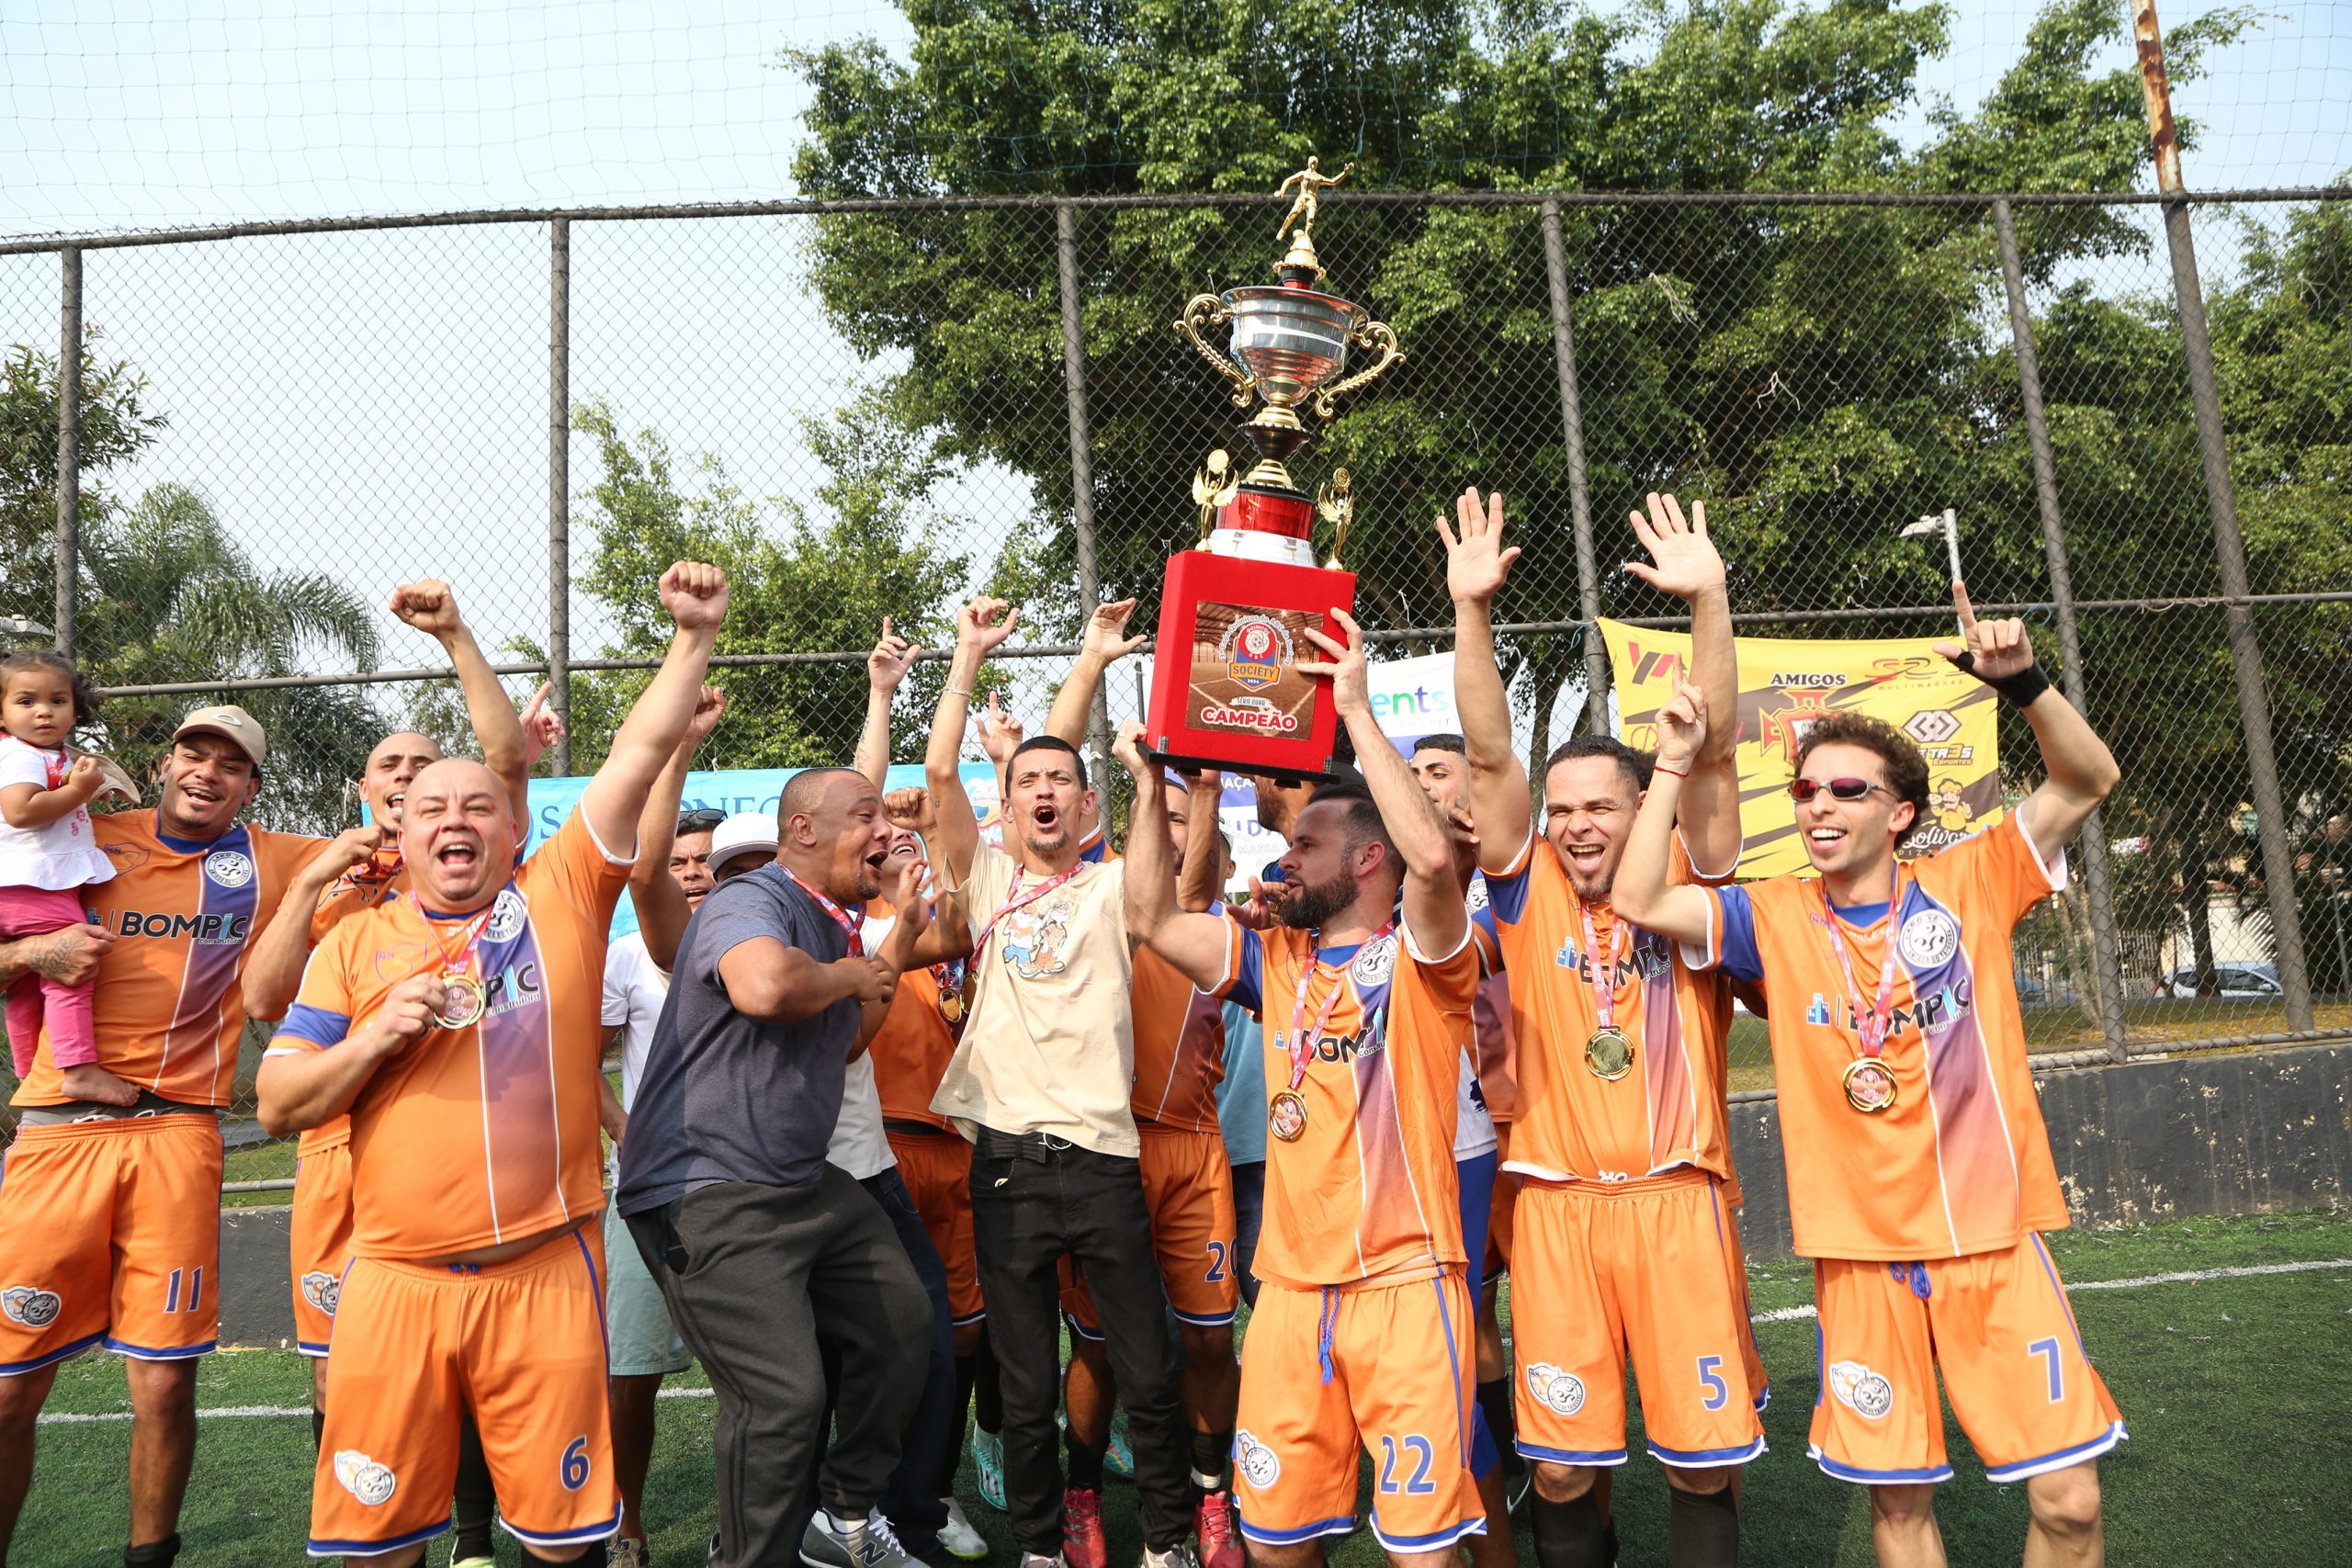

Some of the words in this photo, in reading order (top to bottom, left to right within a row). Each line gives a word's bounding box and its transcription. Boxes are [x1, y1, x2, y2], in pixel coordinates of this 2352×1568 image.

[1233, 665, 1276, 678] SOCIETY
[1770, 672, 1846, 685] AMIGOS
[1878, 680, 1963, 690] MULTIMARCAS
[1202, 708, 1297, 730] CAMPEÃO
[120, 911, 247, 938] BOMPIC
[482, 963, 539, 1010] PIC
[163, 1266, 203, 1314] 11
[1696, 1354, 1729, 1411] 5
[2028, 1334, 2064, 1404] 7
[560, 1434, 591, 1493] 6
[1380, 1433, 1438, 1496] 22
[853, 1540, 888, 1567] N
